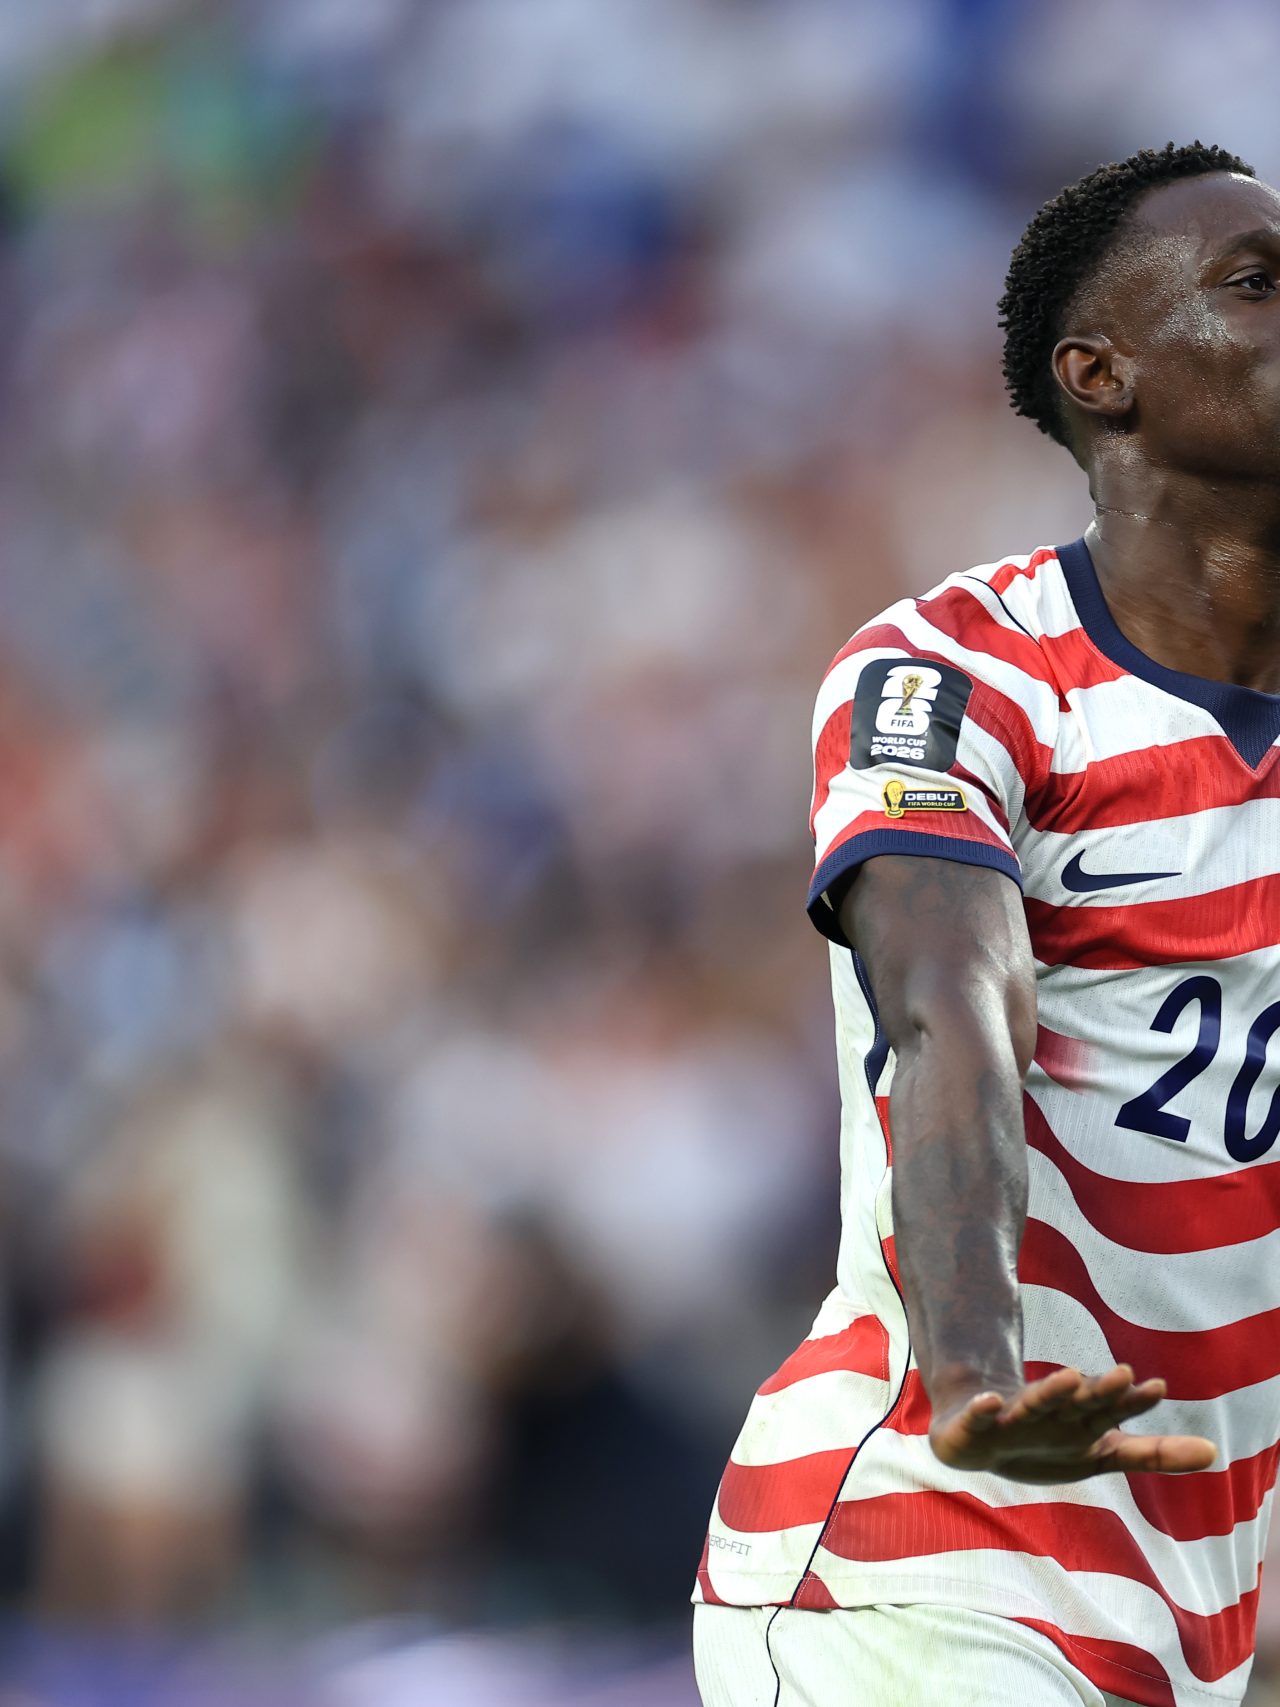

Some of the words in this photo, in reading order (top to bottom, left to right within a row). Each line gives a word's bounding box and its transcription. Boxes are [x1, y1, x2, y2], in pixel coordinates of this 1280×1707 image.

[890, 719, 914, 728] FIFA
[872, 736, 906, 745] WORLD
[907, 738, 927, 747] CUP
[870, 744, 925, 760] 2026
[904, 793, 958, 801] DEBUT
